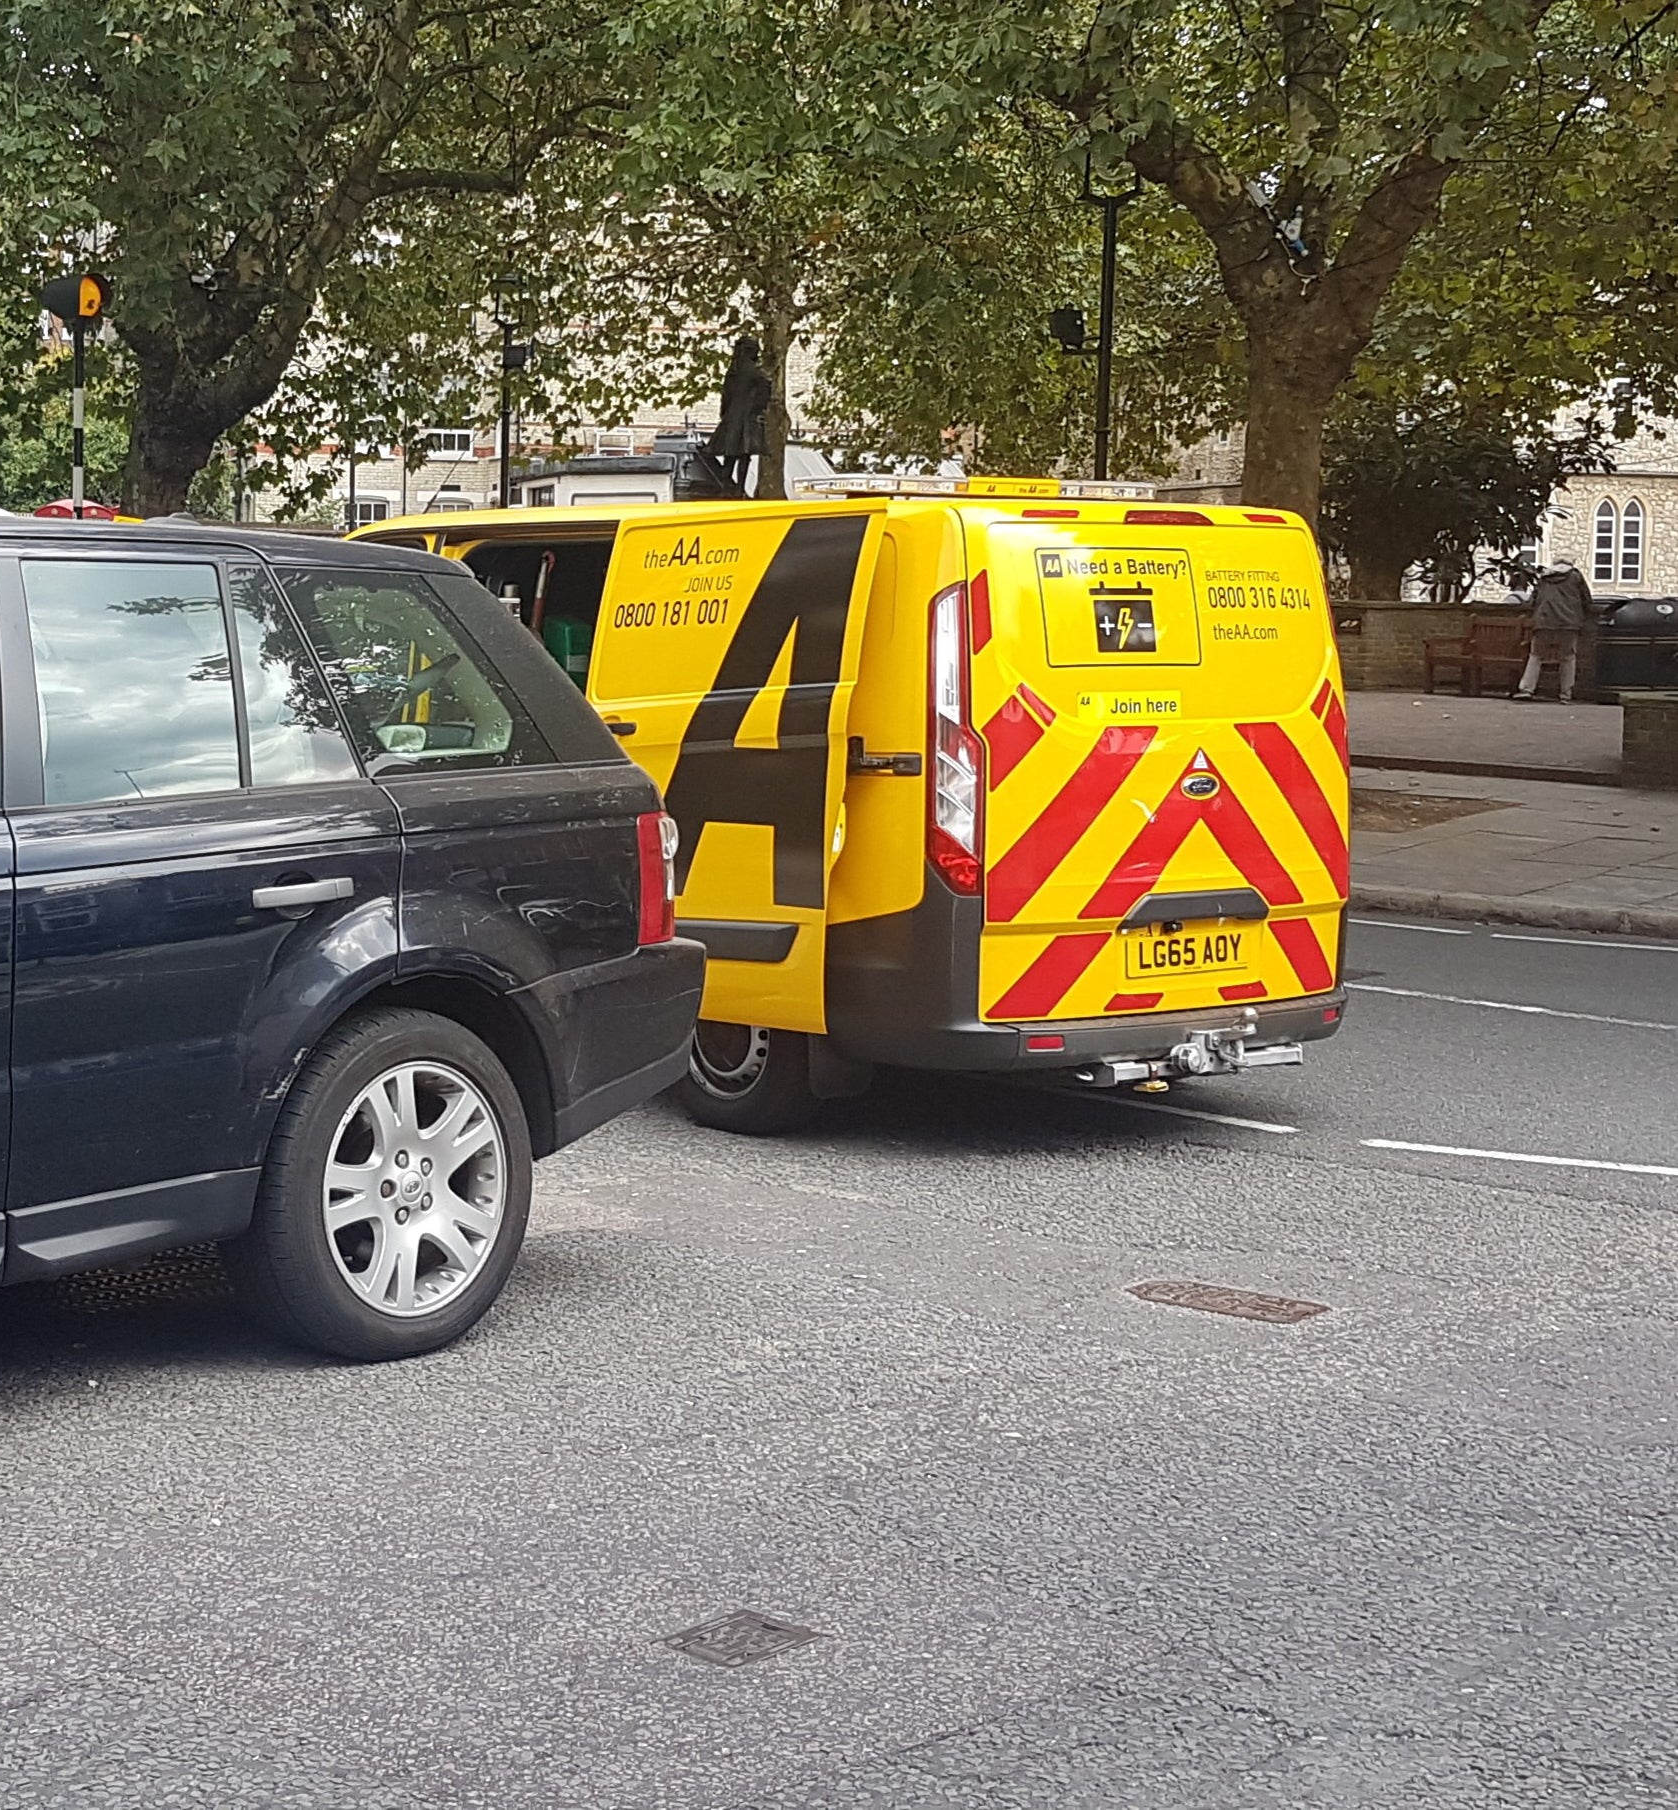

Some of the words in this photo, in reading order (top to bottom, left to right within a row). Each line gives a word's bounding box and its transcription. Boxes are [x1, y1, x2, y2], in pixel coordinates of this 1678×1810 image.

[643, 536, 740, 568] theAA.com
[1043, 557, 1062, 575] AA
[1066, 558, 1109, 574] Need
[1114, 563, 1122, 574] a
[1126, 558, 1187, 580] Battery?
[1205, 570, 1245, 582] BATTERY
[1247, 570, 1280, 583] FITTING
[683, 576, 713, 594] JOIN
[716, 574, 733, 591] US
[1208, 586, 1246, 609] 0800
[1249, 586, 1277, 609] 316
[1281, 587, 1311, 611] 4314
[614, 602, 656, 628] 0800
[662, 600, 691, 627] 181
[697, 598, 729, 625] 001
[1213, 623, 1279, 641] theAA.com
[1110, 697, 1142, 714] Join
[1146, 697, 1178, 713] here
[1139, 937, 1196, 970] LG65
[1203, 933, 1242, 964] AOY
